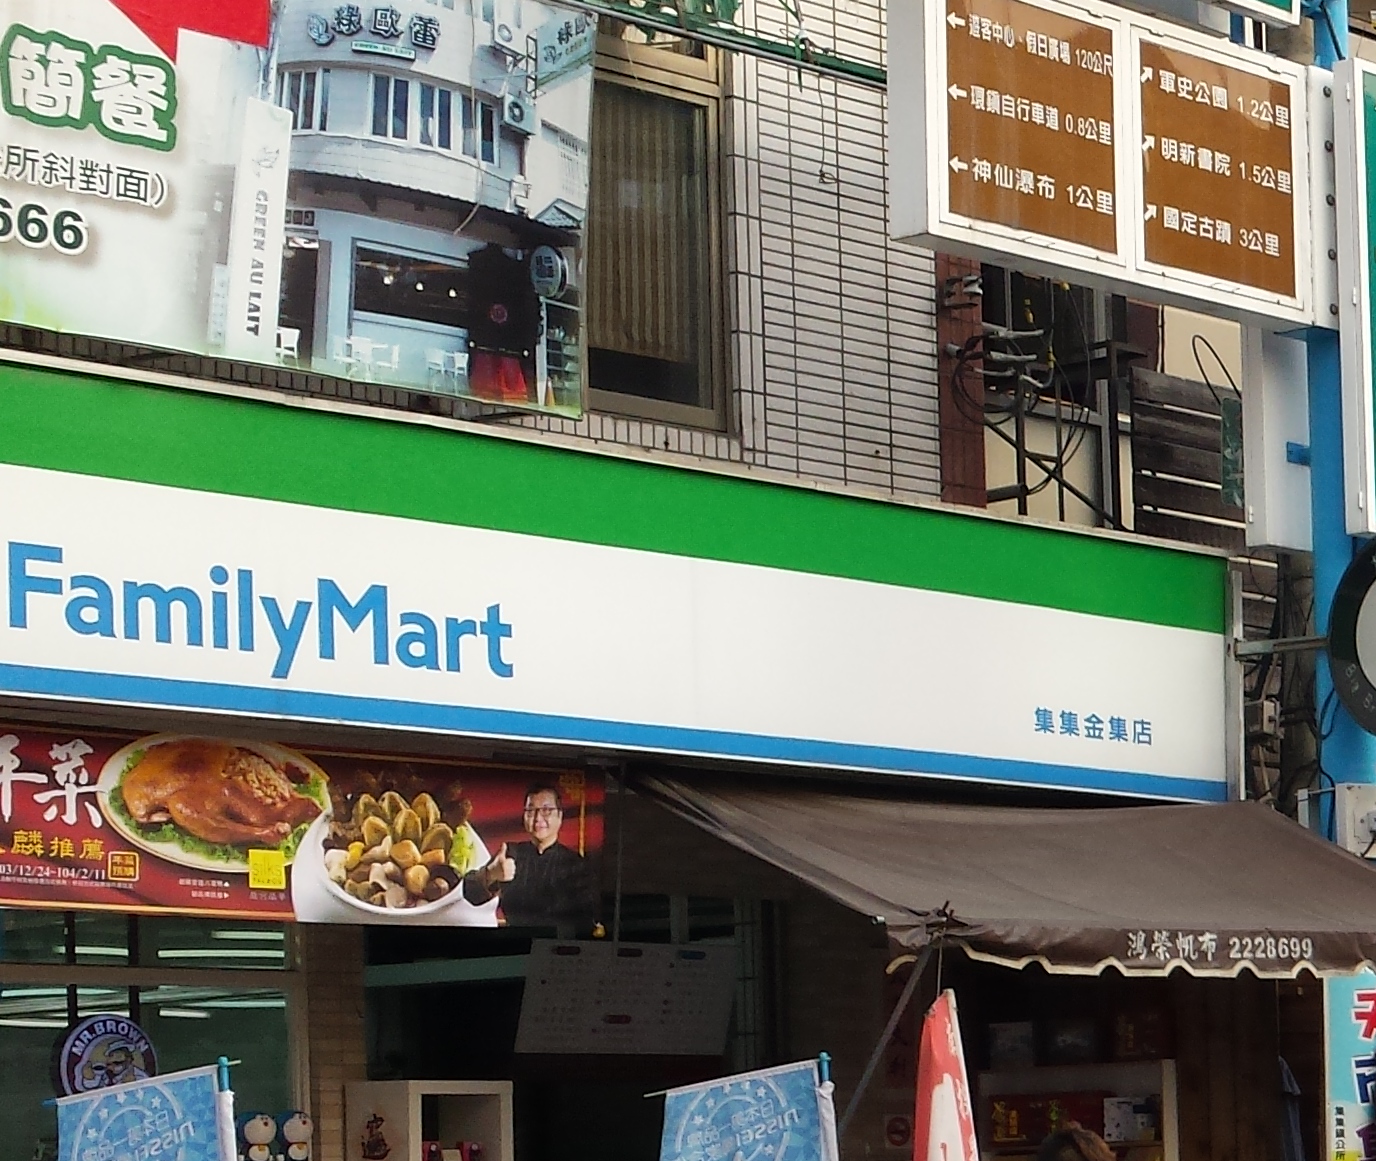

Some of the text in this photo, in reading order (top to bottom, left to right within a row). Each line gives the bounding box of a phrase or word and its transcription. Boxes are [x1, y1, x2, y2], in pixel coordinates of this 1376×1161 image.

[6, 30, 173, 145] 簡餐
[1075, 49, 1113, 77] 120公尺
[1159, 70, 1290, 129] 軍史公園 1.2公里
[1065, 114, 1112, 146] 0.8公里
[0, 145, 168, 208] 所斜對面)
[971, 159, 1114, 215] 神仙瀑布 1公里
[1161, 138, 1291, 195] 明新書院 1.5公里
[1163, 208, 1280, 257] 國定古蹟 3公里
[247, 189, 268, 336] GREEN AU LAIT
[8, 541, 514, 678] FamilyMart
[1033, 707, 1153, 746] 集集金集店
[0, 830, 105, 860] 麟推薦
[1229, 936, 1313, 960] 2228699
[72, 1018, 150, 1058] MR.BROWN
[1334, 1106, 1346, 1161] 集集鎮公所
